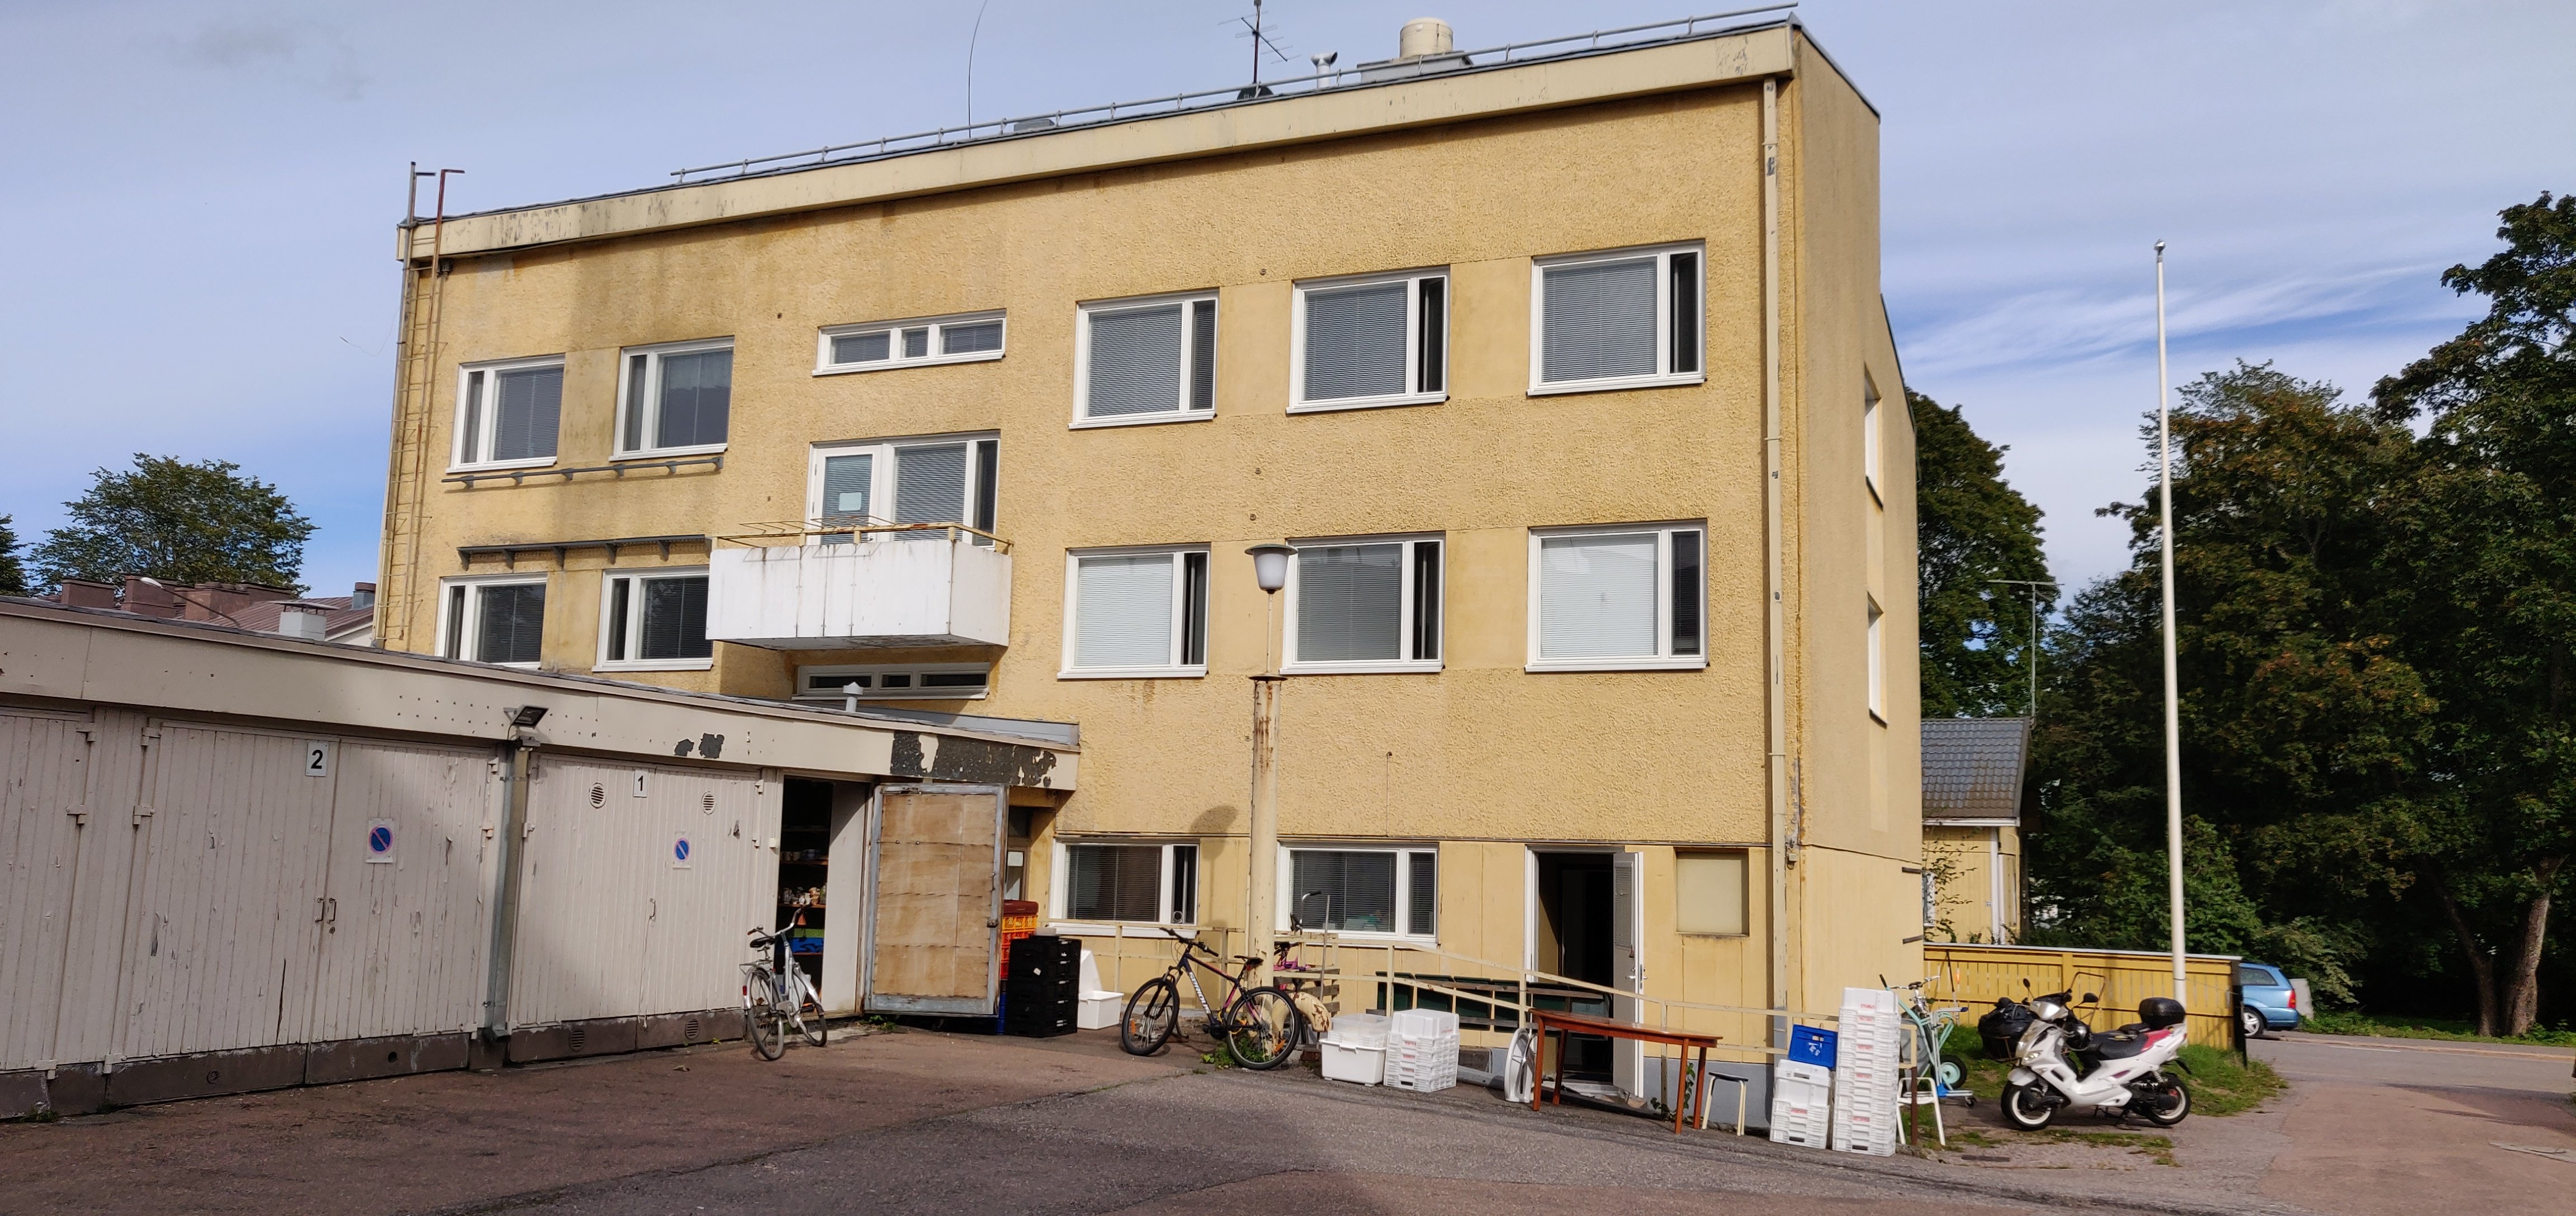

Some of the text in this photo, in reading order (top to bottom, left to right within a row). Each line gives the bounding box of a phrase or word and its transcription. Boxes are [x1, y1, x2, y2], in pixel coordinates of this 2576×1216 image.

[310, 749, 323, 770] 2
[637, 775, 643, 791] 1
[1189, 972, 1211, 1014] SERIOUS
